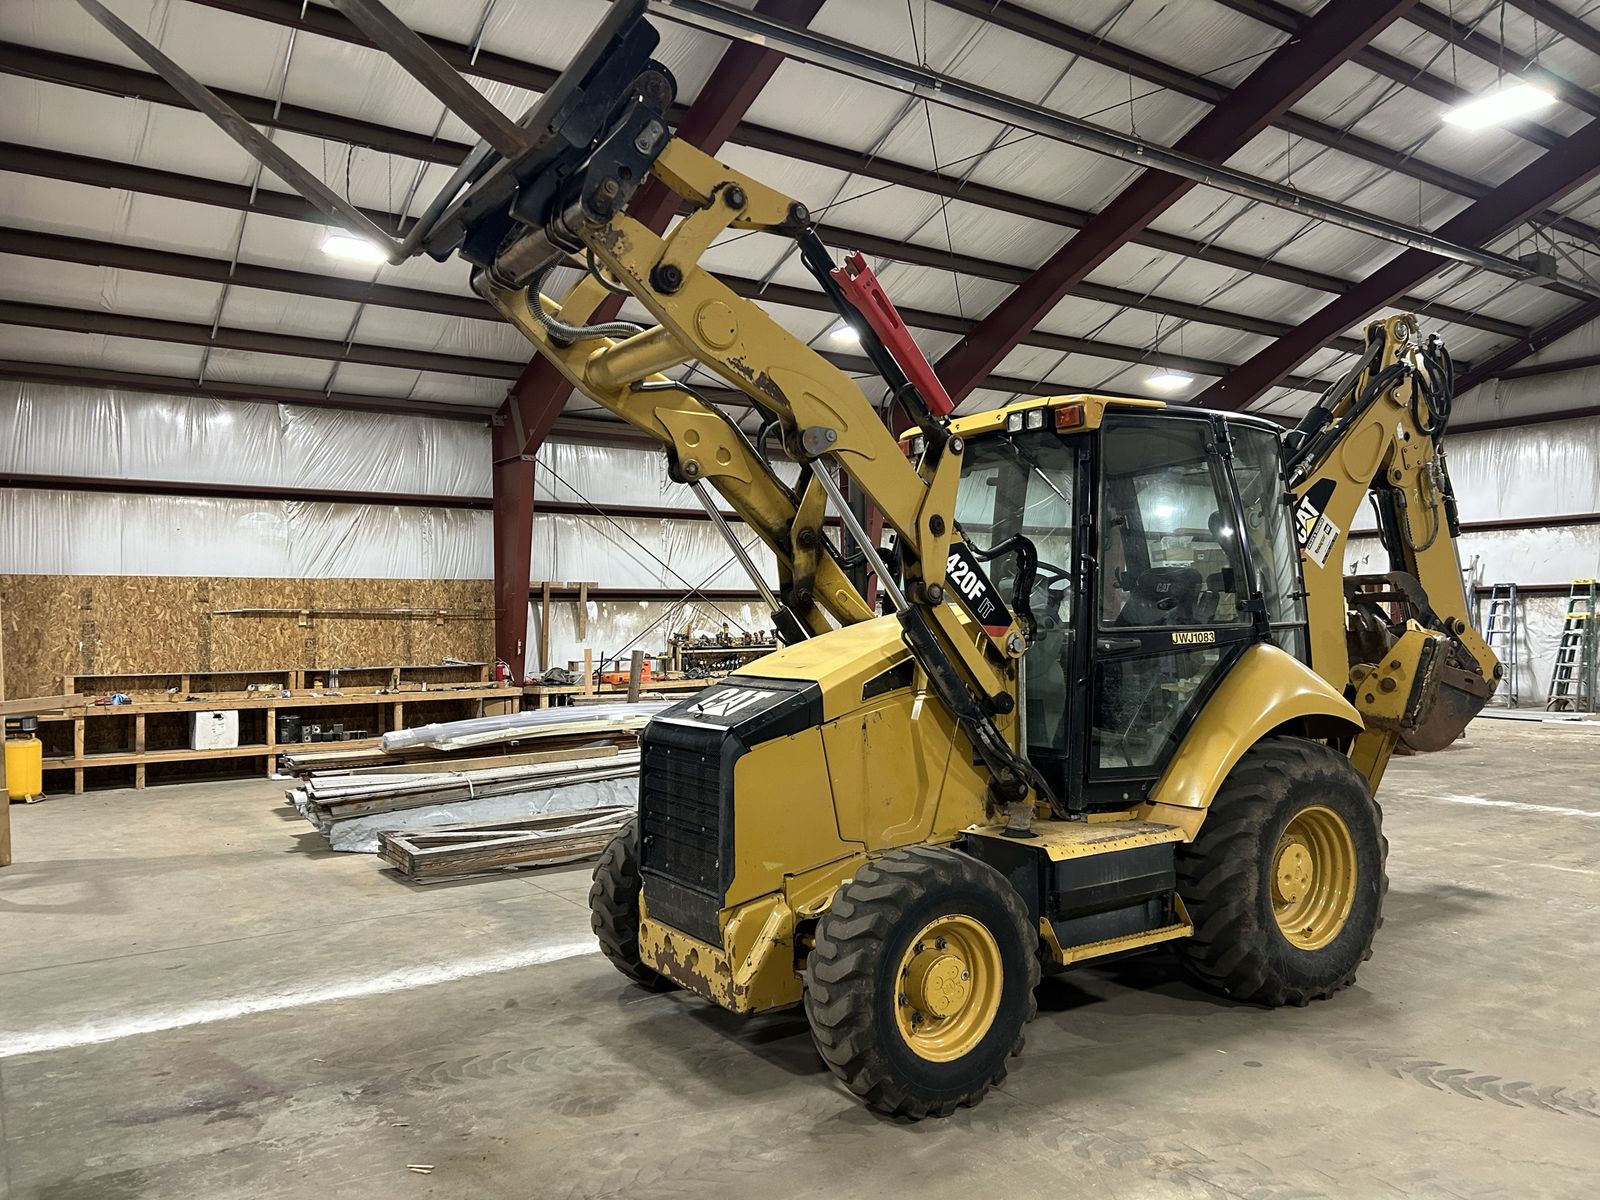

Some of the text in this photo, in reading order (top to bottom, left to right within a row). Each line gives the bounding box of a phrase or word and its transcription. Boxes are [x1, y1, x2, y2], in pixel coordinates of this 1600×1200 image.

[1296, 495, 1320, 544] CAT
[946, 553, 996, 619] 420F IT
[1155, 583, 1171, 593] CAT
[1172, 632, 1215, 644] JWJ1083
[686, 688, 777, 717] CAT
